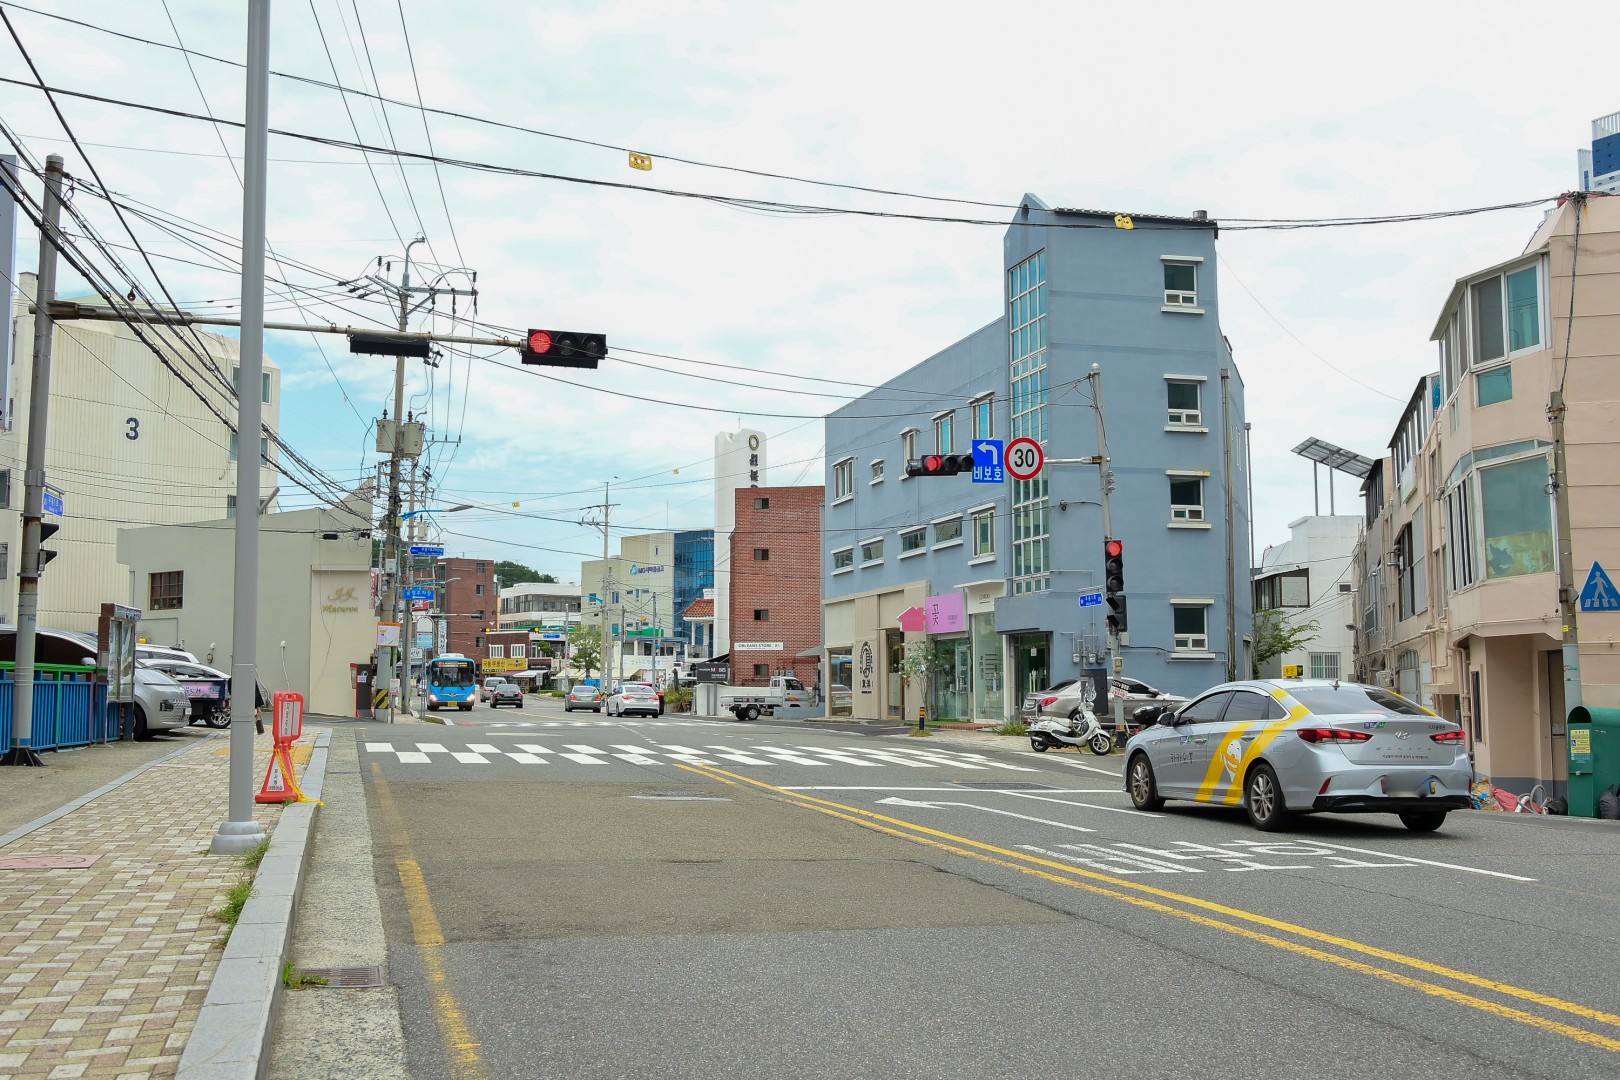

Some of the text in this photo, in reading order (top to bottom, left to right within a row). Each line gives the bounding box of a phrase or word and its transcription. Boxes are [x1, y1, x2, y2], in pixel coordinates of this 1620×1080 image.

[126, 416, 140, 441] 3
[1014, 448, 1035, 468] 30
[973, 465, 1003, 481] 비보호
